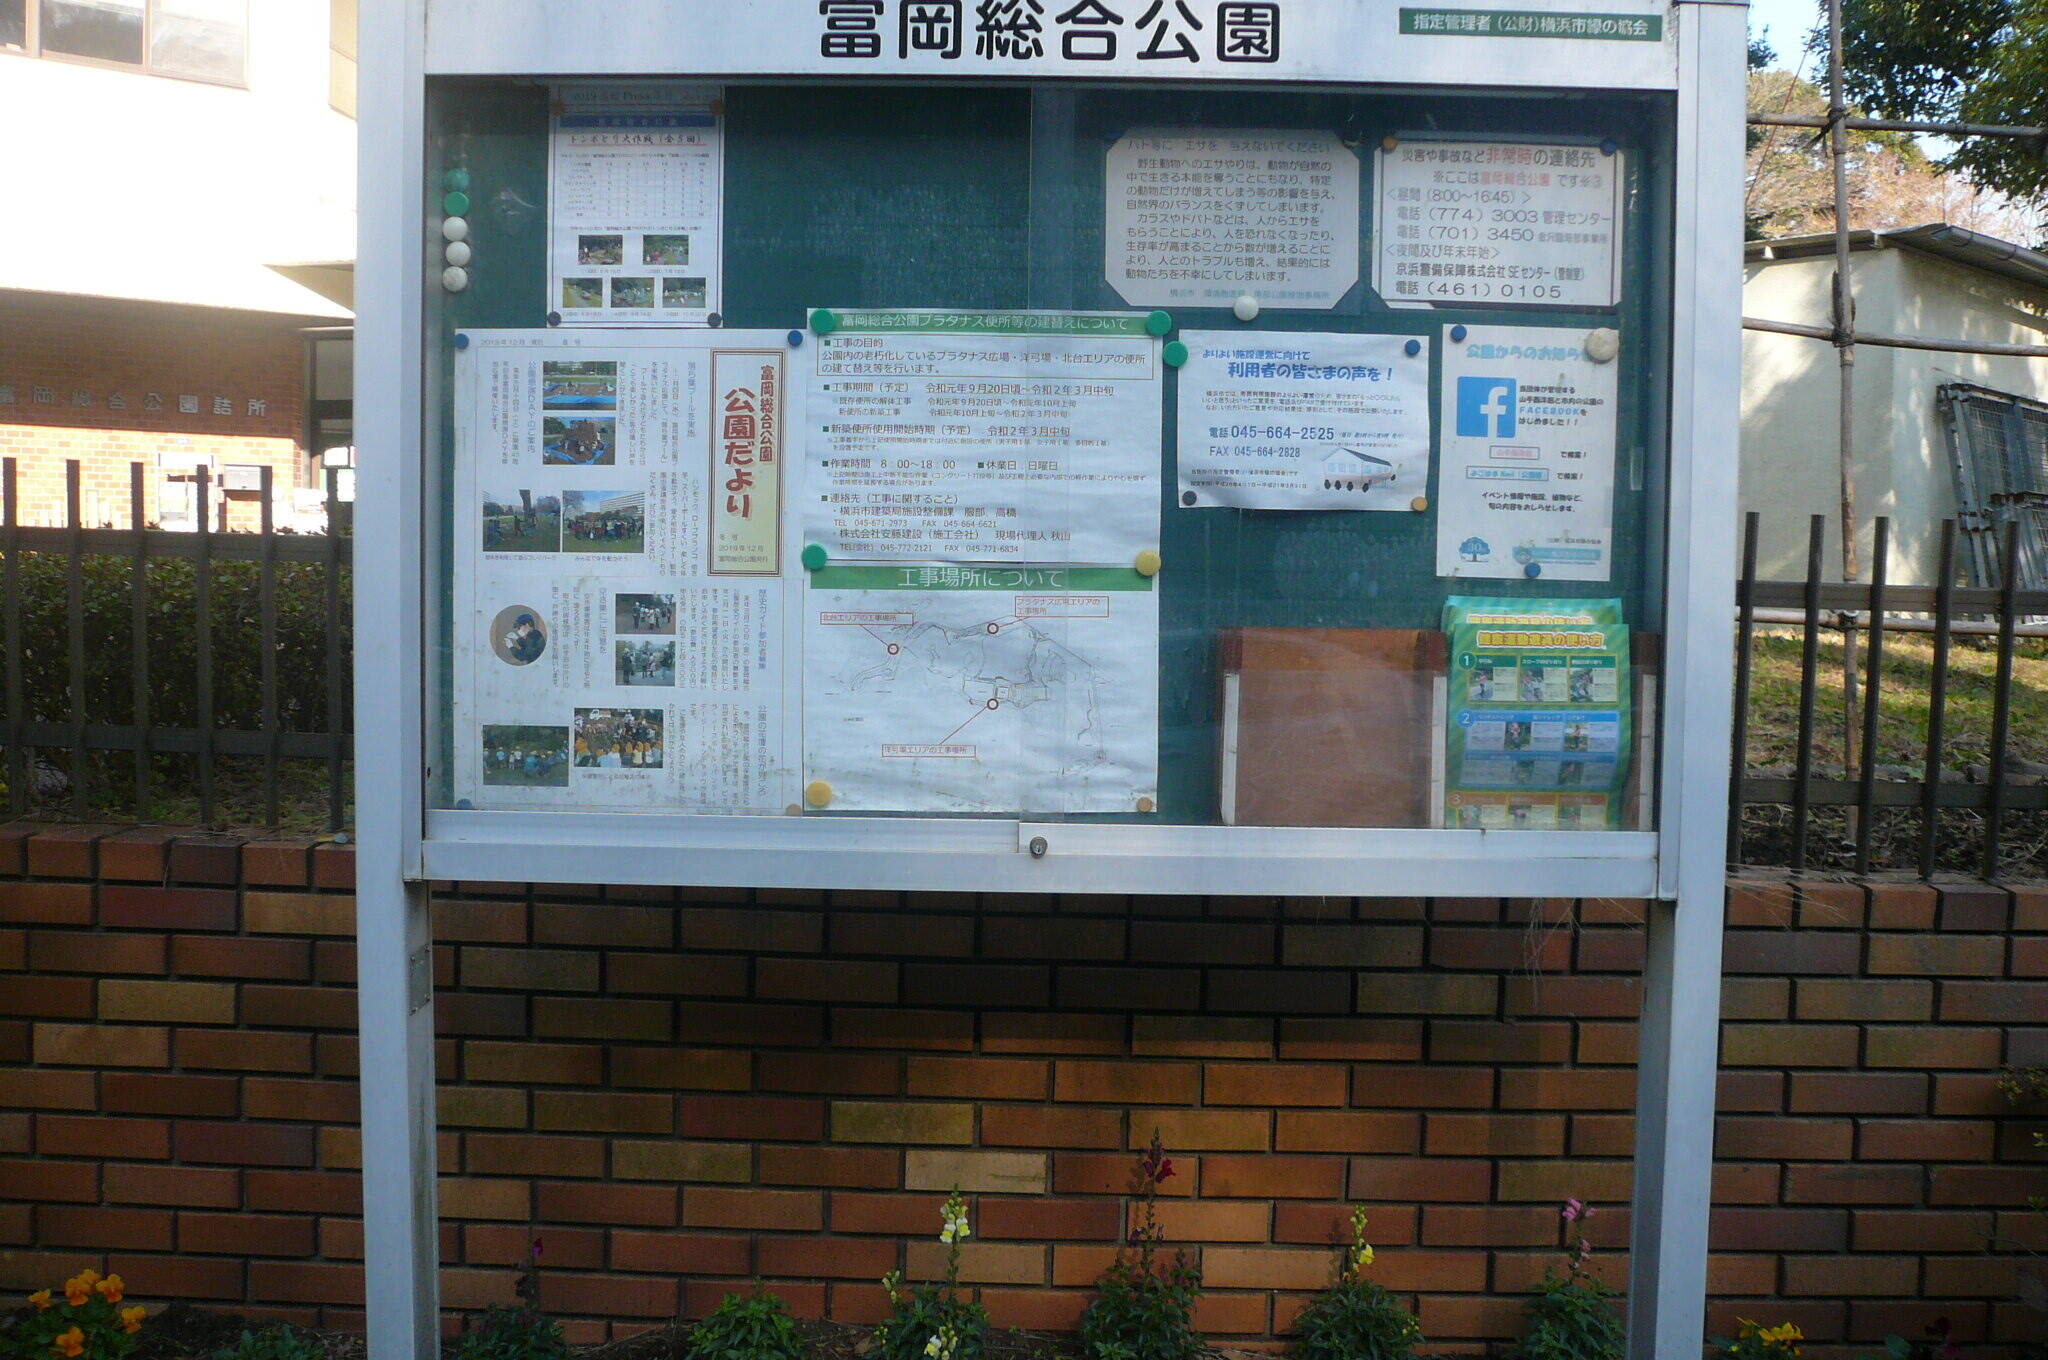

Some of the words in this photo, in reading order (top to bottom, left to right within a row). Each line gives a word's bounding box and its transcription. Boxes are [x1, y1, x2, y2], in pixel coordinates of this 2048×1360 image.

[1413, 13, 1491, 32] 指定管理者
[819, 0, 1279, 64] 富岡総合公園
[842, 314, 1130, 332] 富岡総合公園プラタナス便所等の建替えについて
[832, 337, 884, 349] 工事の目的
[822, 362, 940, 375] の建て替え等を行います。
[1228, 361, 1394, 383] 利用者の皆さまの声を！
[759, 365, 775, 462] 富岡総合公園
[1208, 427, 1229, 439] 電話
[1231, 424, 1335, 441] 045-664-2525
[723, 387, 757, 519] 公園だより
[1209, 446, 1230, 458] FAX
[1234, 446, 1301, 459] 045-664-2828
[831, 458, 871, 470] 作業時間
[922, 520, 937, 528] FAX
[944, 545, 960, 553] FAX
[898, 567, 1065, 589] 工事場所について
[1463, 655, 1470, 666] 1
[1462, 712, 1470, 725] 2
